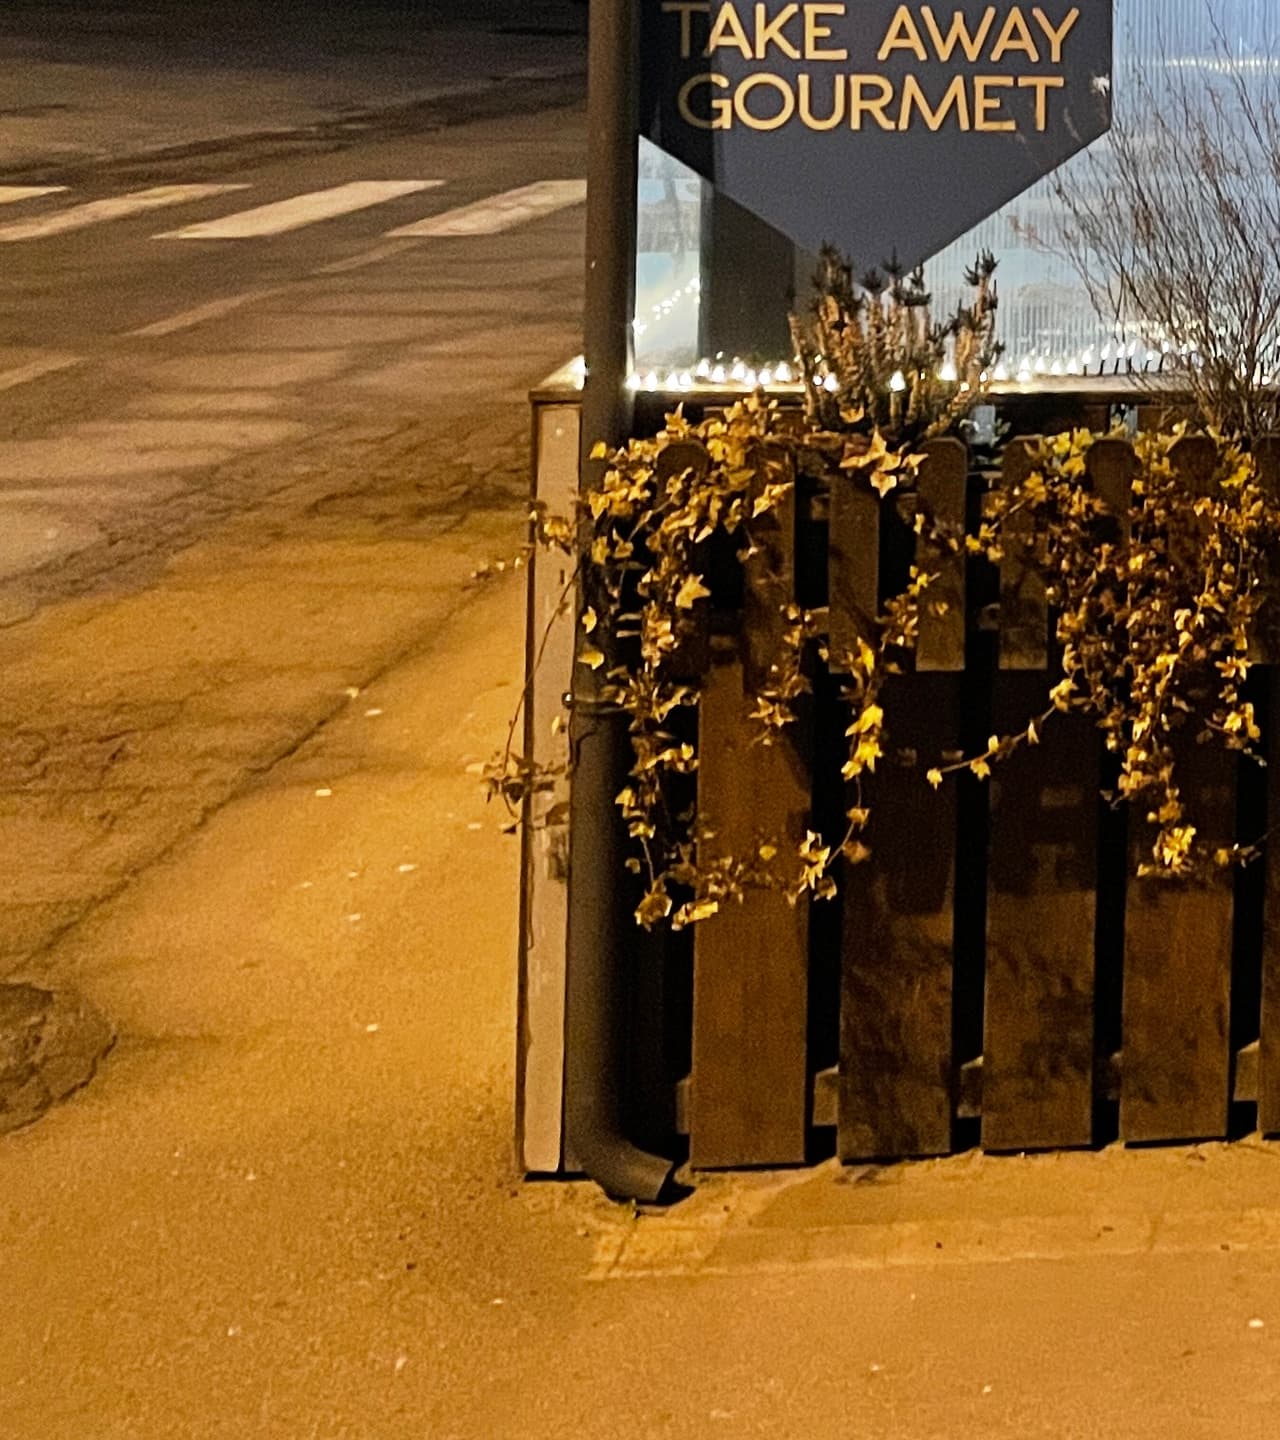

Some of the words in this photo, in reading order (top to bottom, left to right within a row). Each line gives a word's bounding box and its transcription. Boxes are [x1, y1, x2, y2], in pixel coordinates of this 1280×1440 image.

[661, 1, 848, 61] TAKE
[876, 4, 1080, 63] AWAY
[677, 71, 1065, 132] GOURMET
